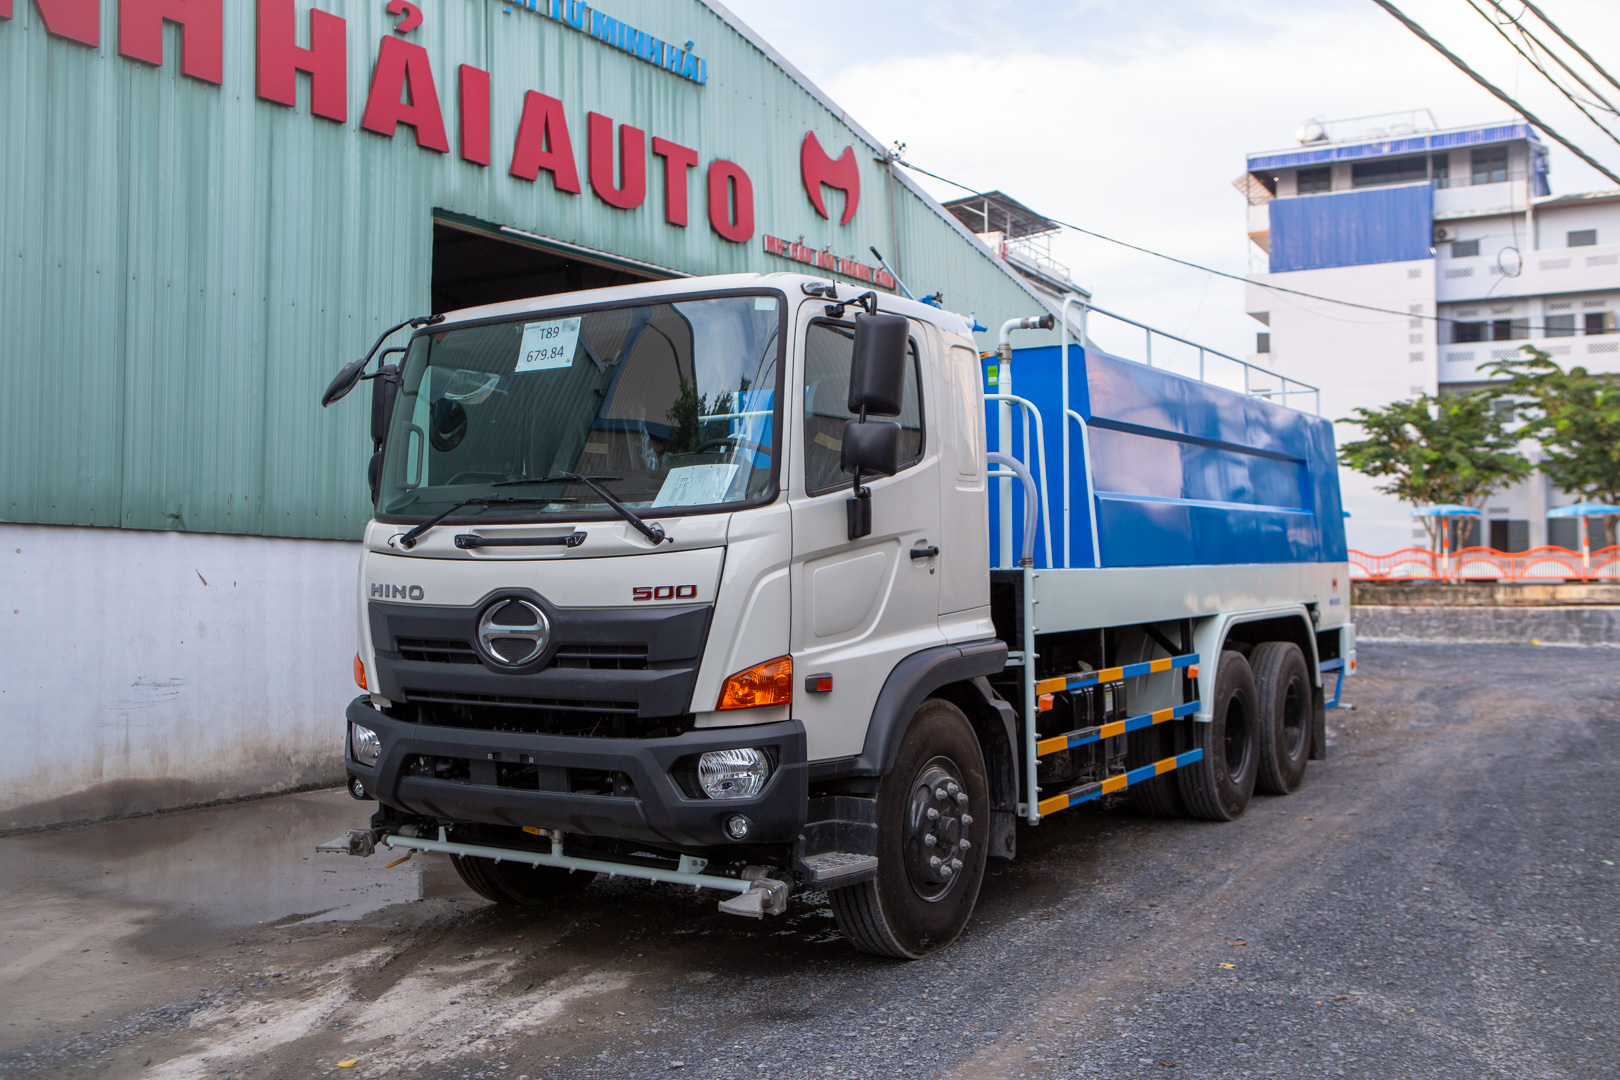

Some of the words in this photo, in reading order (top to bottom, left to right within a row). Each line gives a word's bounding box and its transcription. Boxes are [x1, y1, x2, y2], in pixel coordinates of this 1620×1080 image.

[590, 8, 662, 68] MINH
[663, 40, 707, 85] HẢI
[256, 0, 490, 166] HẢI
[510, 89, 754, 243] AUTO
[540, 326, 560, 340] T89
[526, 345, 565, 363] 679.84
[370, 583, 425, 601] HINO
[632, 584, 698, 602] 500
